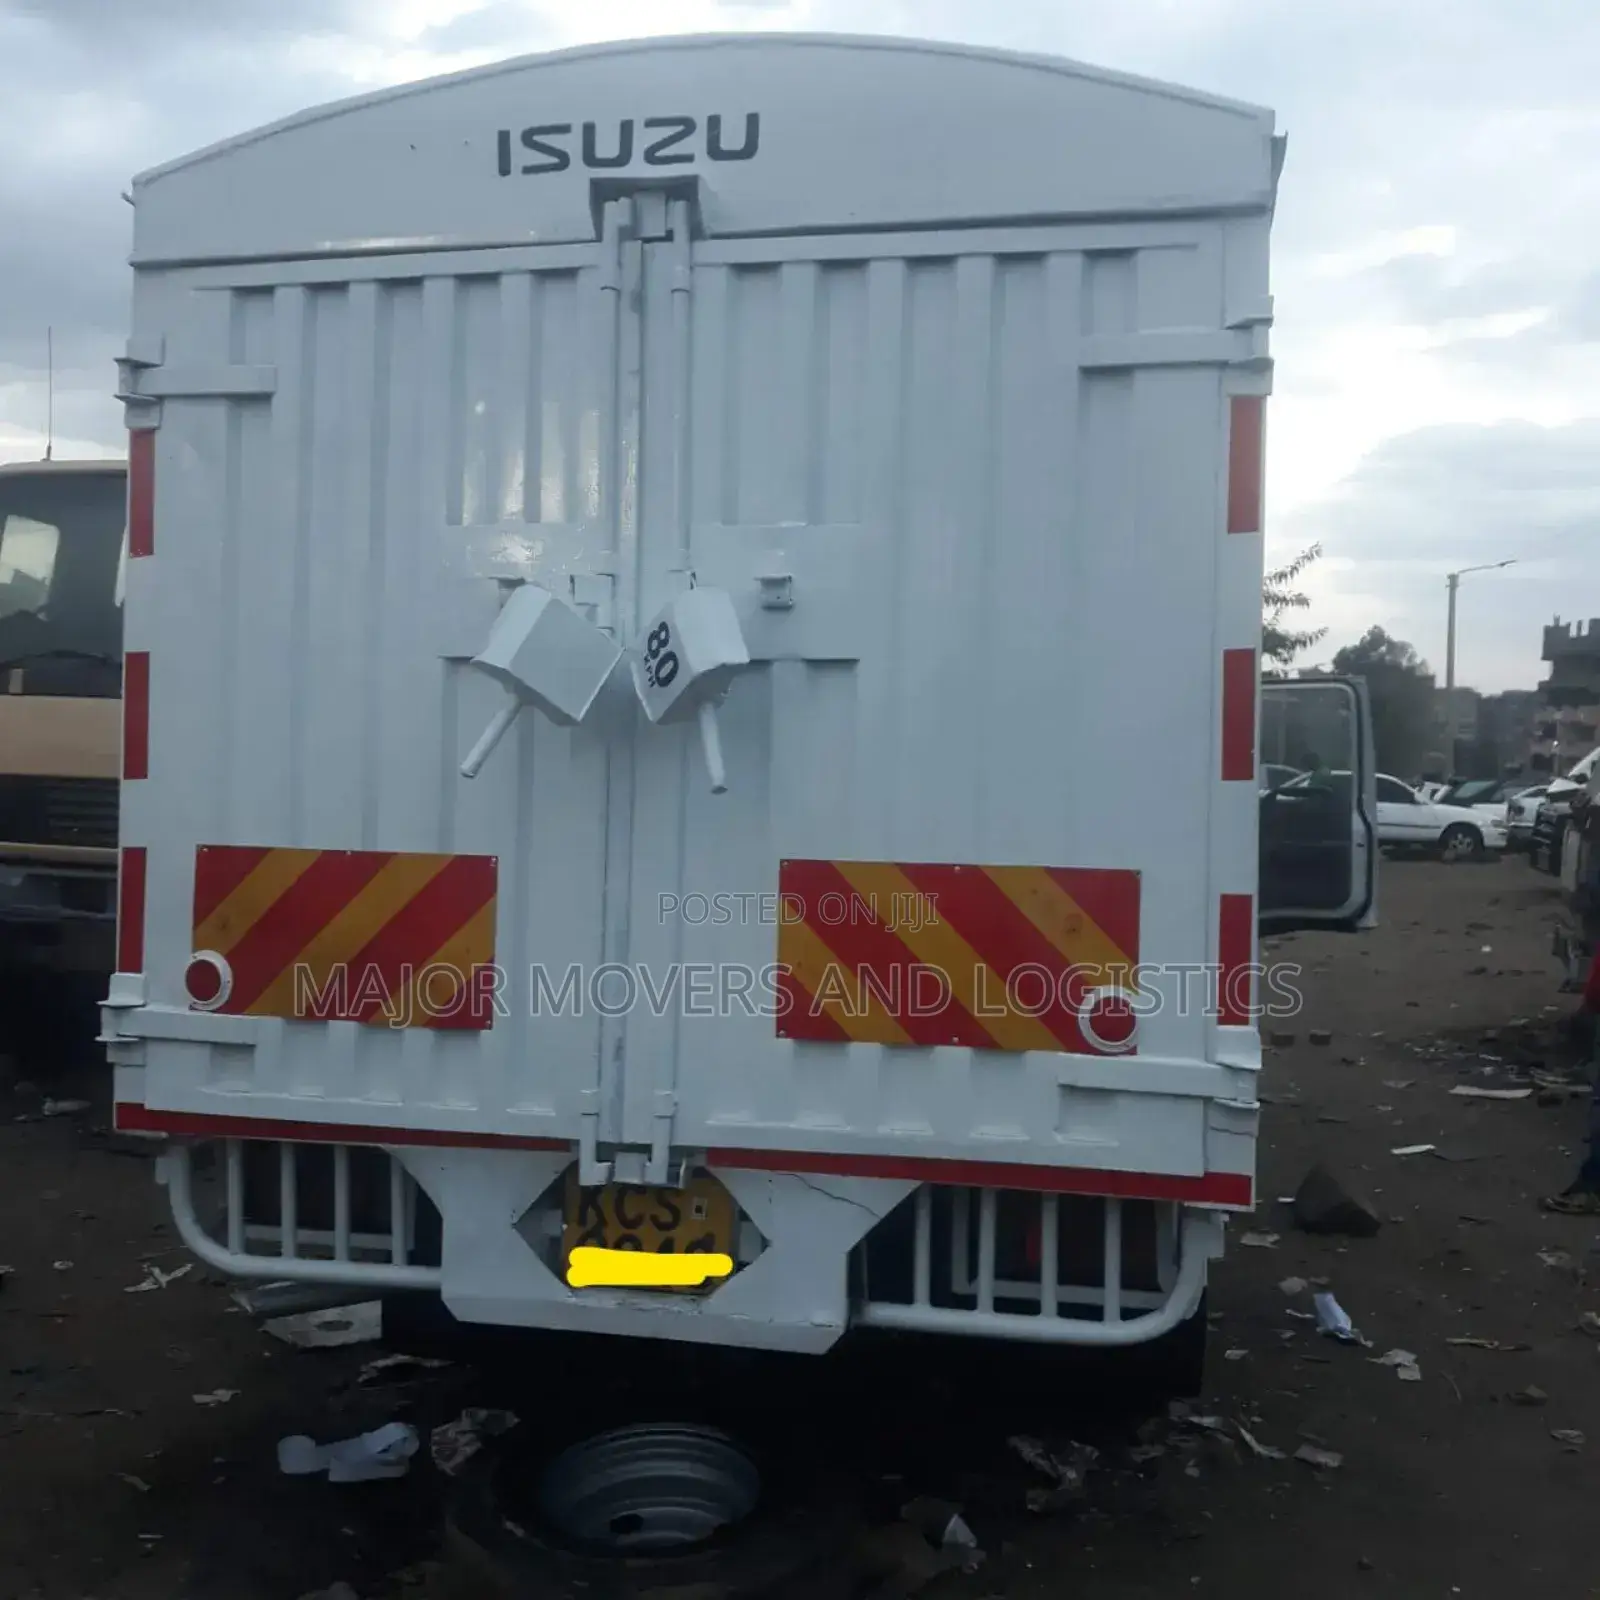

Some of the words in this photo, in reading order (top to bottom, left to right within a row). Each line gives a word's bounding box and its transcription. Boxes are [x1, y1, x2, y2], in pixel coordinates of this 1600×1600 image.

[497, 112, 760, 177] ISUZU
[647, 621, 679, 688] 80
[578, 1185, 682, 1231] KCS
